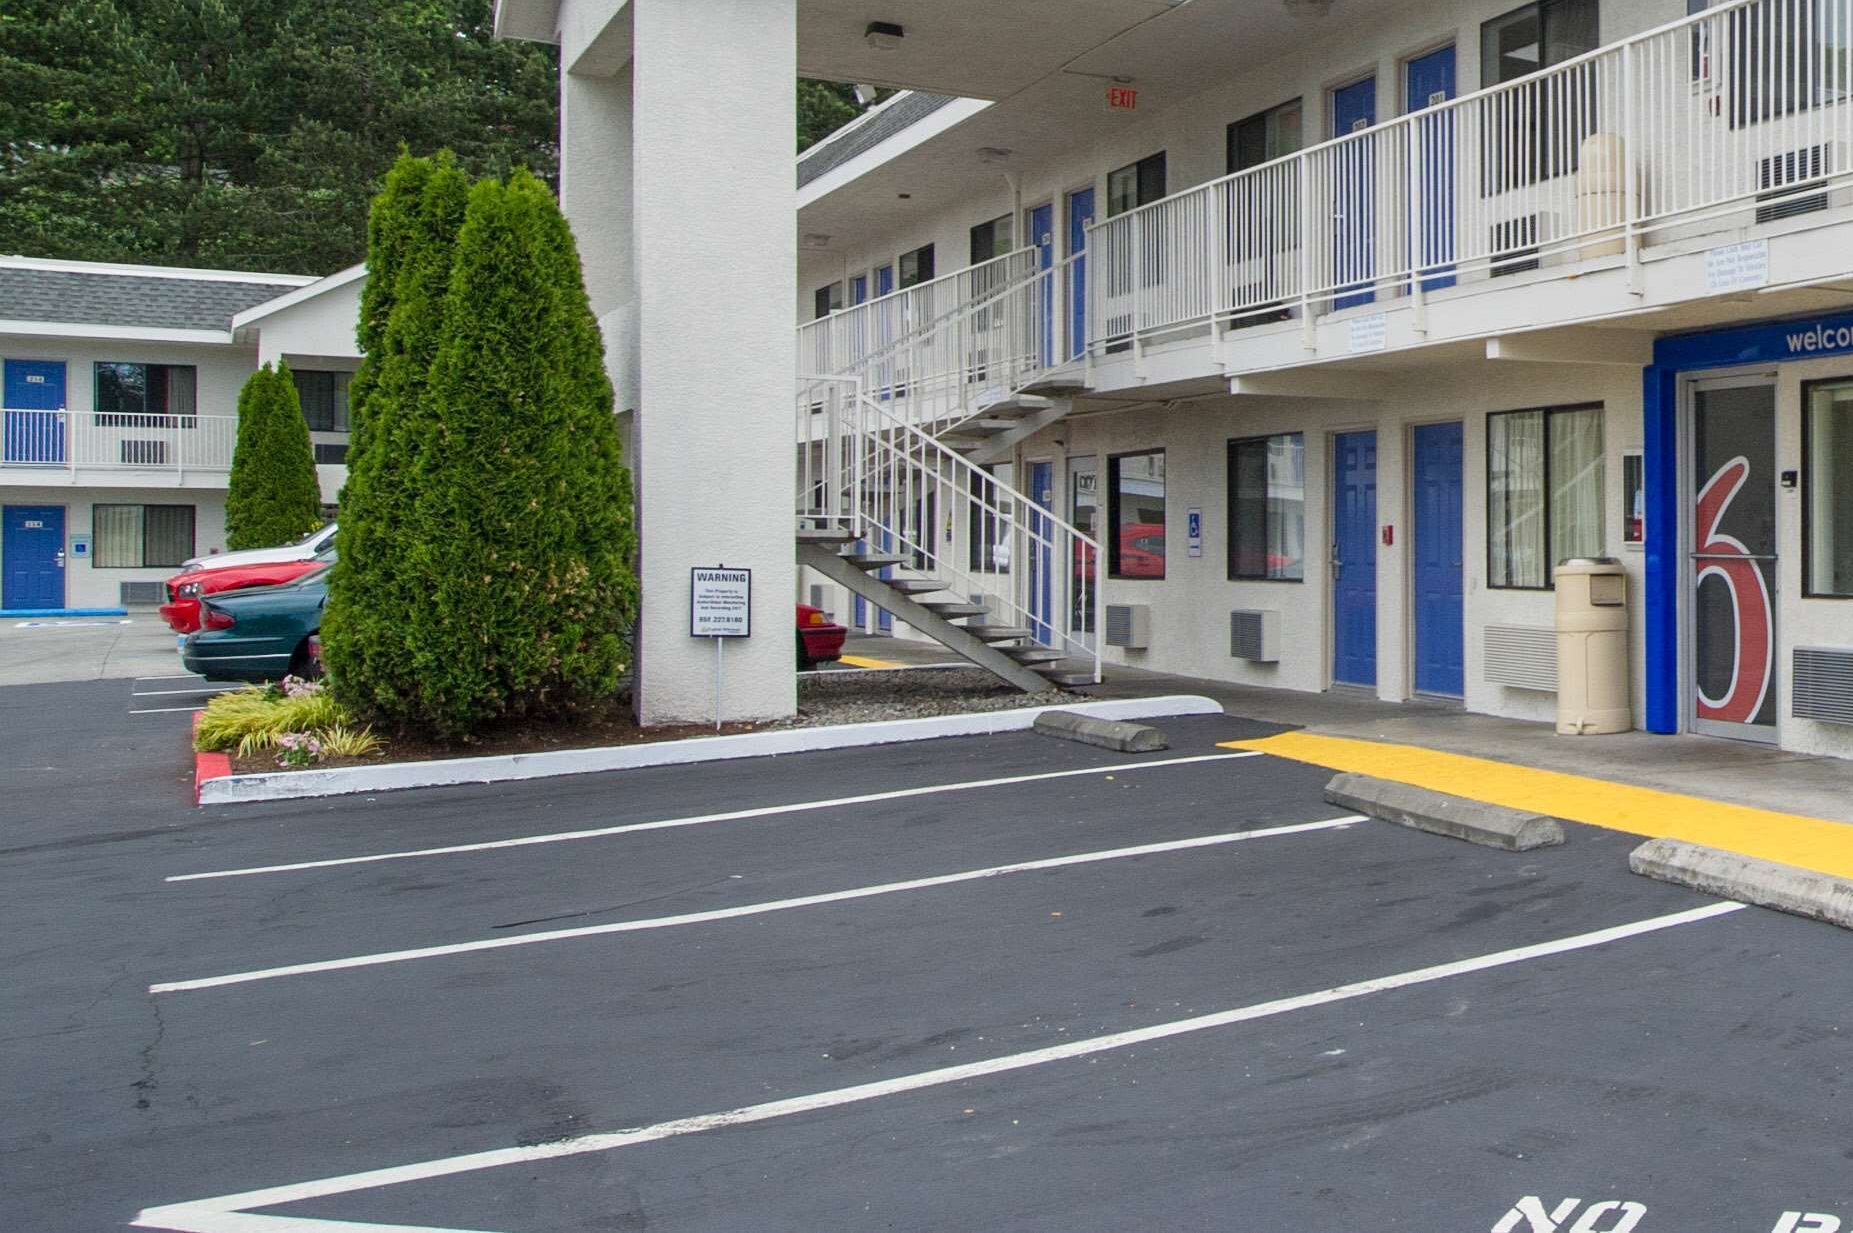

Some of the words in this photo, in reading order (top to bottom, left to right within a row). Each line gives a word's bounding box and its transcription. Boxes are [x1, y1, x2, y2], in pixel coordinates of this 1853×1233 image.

[1110, 87, 1137, 110] EXIT
[697, 573, 746, 583] WARNING
[1697, 455, 1774, 724] 6
[1491, 1196, 1648, 1233] NO
